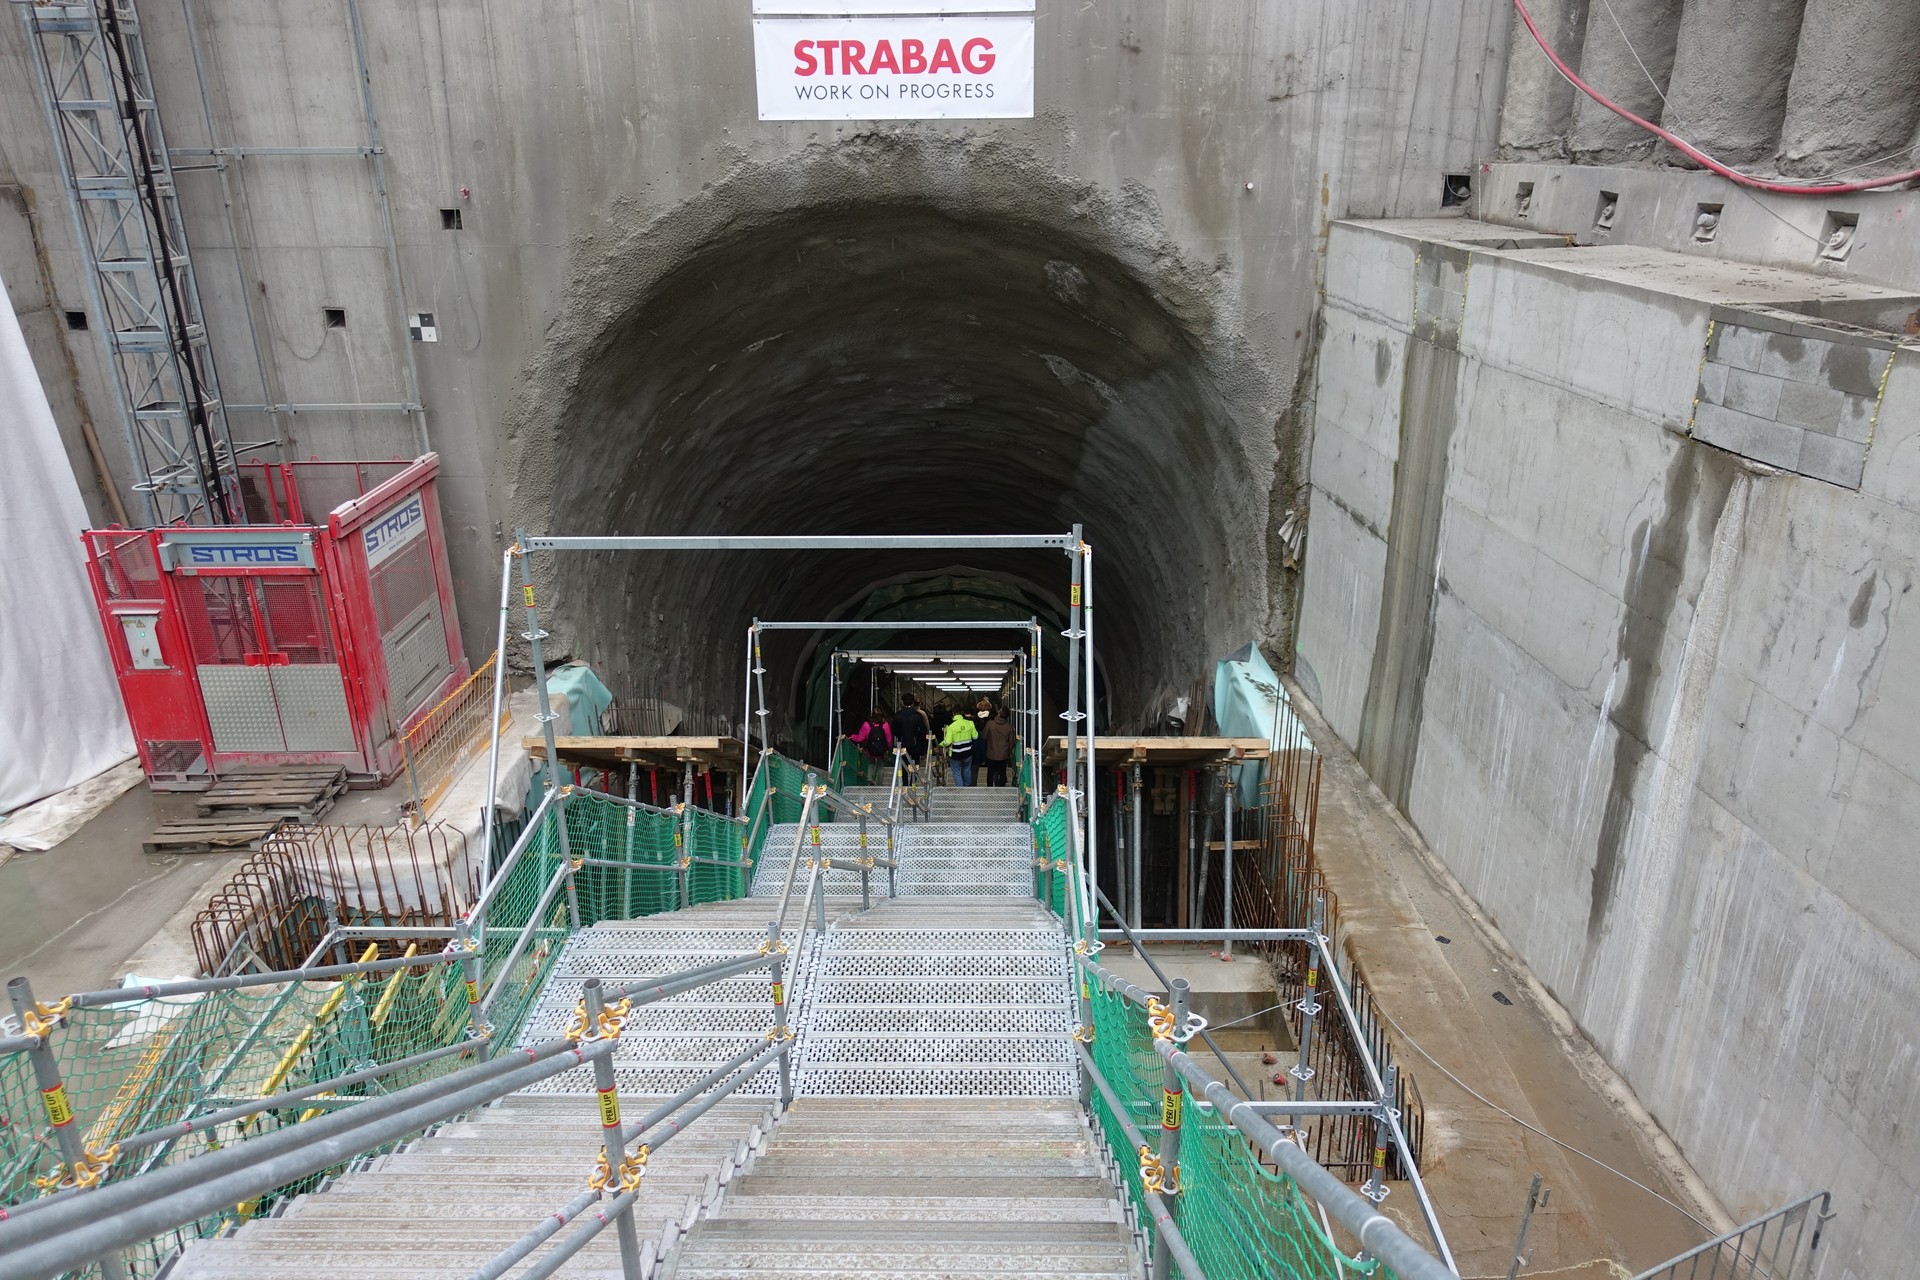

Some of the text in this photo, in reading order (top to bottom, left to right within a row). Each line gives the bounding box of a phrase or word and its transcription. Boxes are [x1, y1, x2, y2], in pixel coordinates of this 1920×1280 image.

[794, 37, 996, 77] STRABAG
[795, 83, 995, 100] WORK ON PROGRESS
[365, 498, 422, 553] STROS
[190, 546, 299, 562] STROS
[46, 1094, 62, 1121] PERI UP
[604, 1094, 614, 1121] PERI UP
[1166, 1096, 1174, 1122] PERI UP
